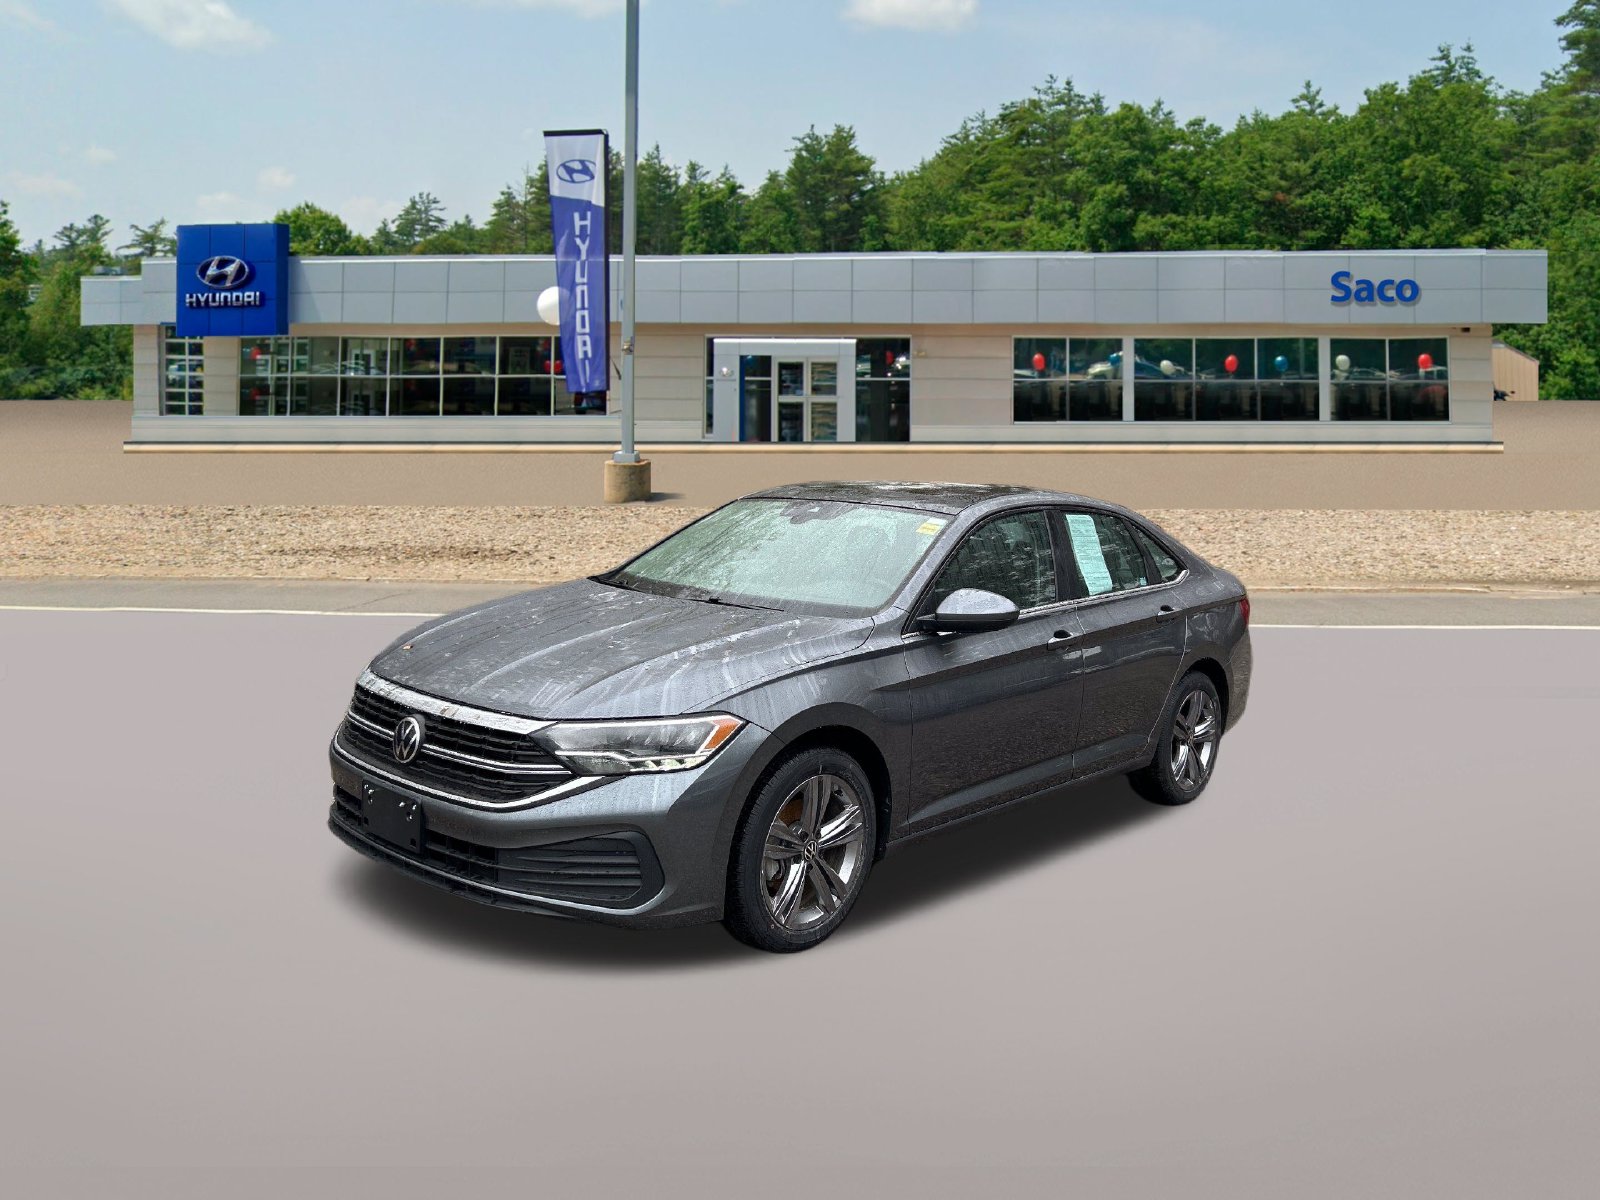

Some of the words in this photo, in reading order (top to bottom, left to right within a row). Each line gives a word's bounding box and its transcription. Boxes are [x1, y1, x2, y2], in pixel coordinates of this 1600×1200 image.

[185, 291, 261, 308] HYUNDAI
[573, 210, 592, 384] HYUNDAI
[1330, 270, 1421, 304] Saco
